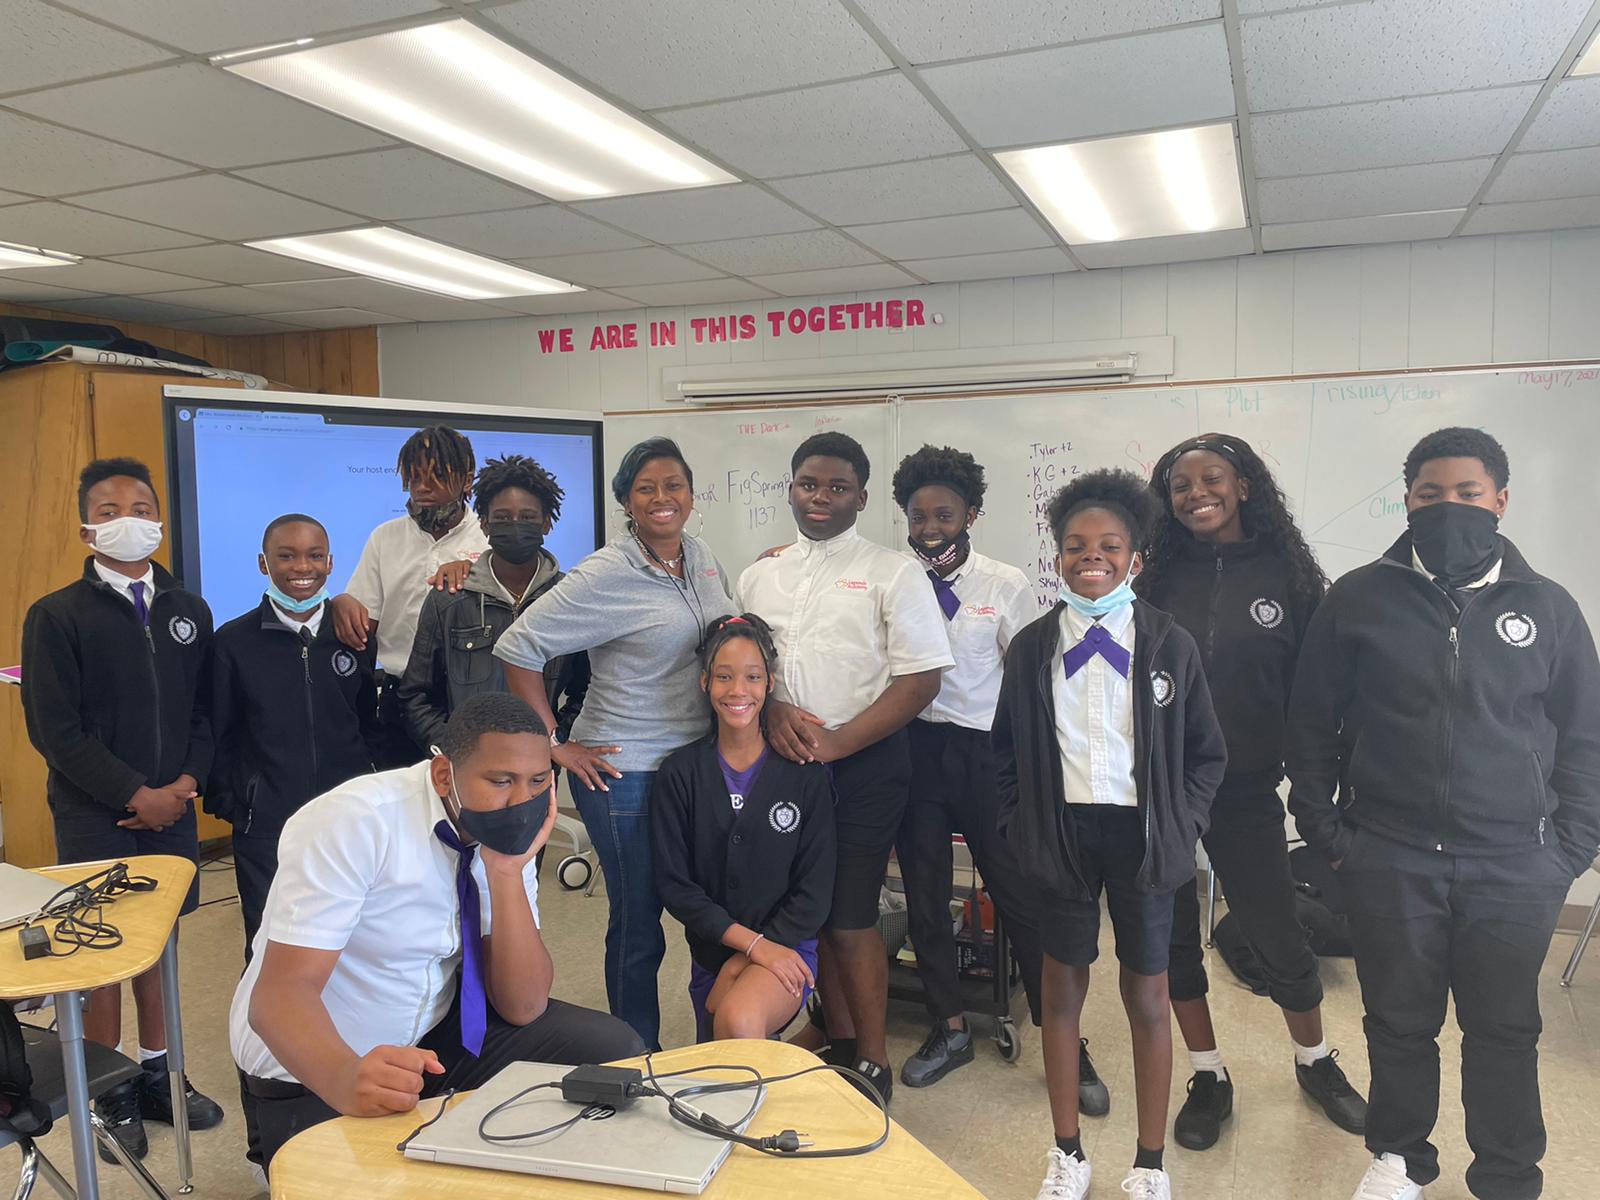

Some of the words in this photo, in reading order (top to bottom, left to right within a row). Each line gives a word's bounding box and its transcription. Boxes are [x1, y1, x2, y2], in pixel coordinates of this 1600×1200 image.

[538, 328, 574, 354] WE
[590, 323, 638, 351] ARE
[650, 320, 676, 347] IN
[690, 315, 756, 343] THIS
[767, 299, 926, 337] TOGETHER
[1225, 387, 1264, 417] Plot
[347, 465, 363, 474] Your
[366, 465, 383, 474] host
[749, 506, 777, 529] 1137
